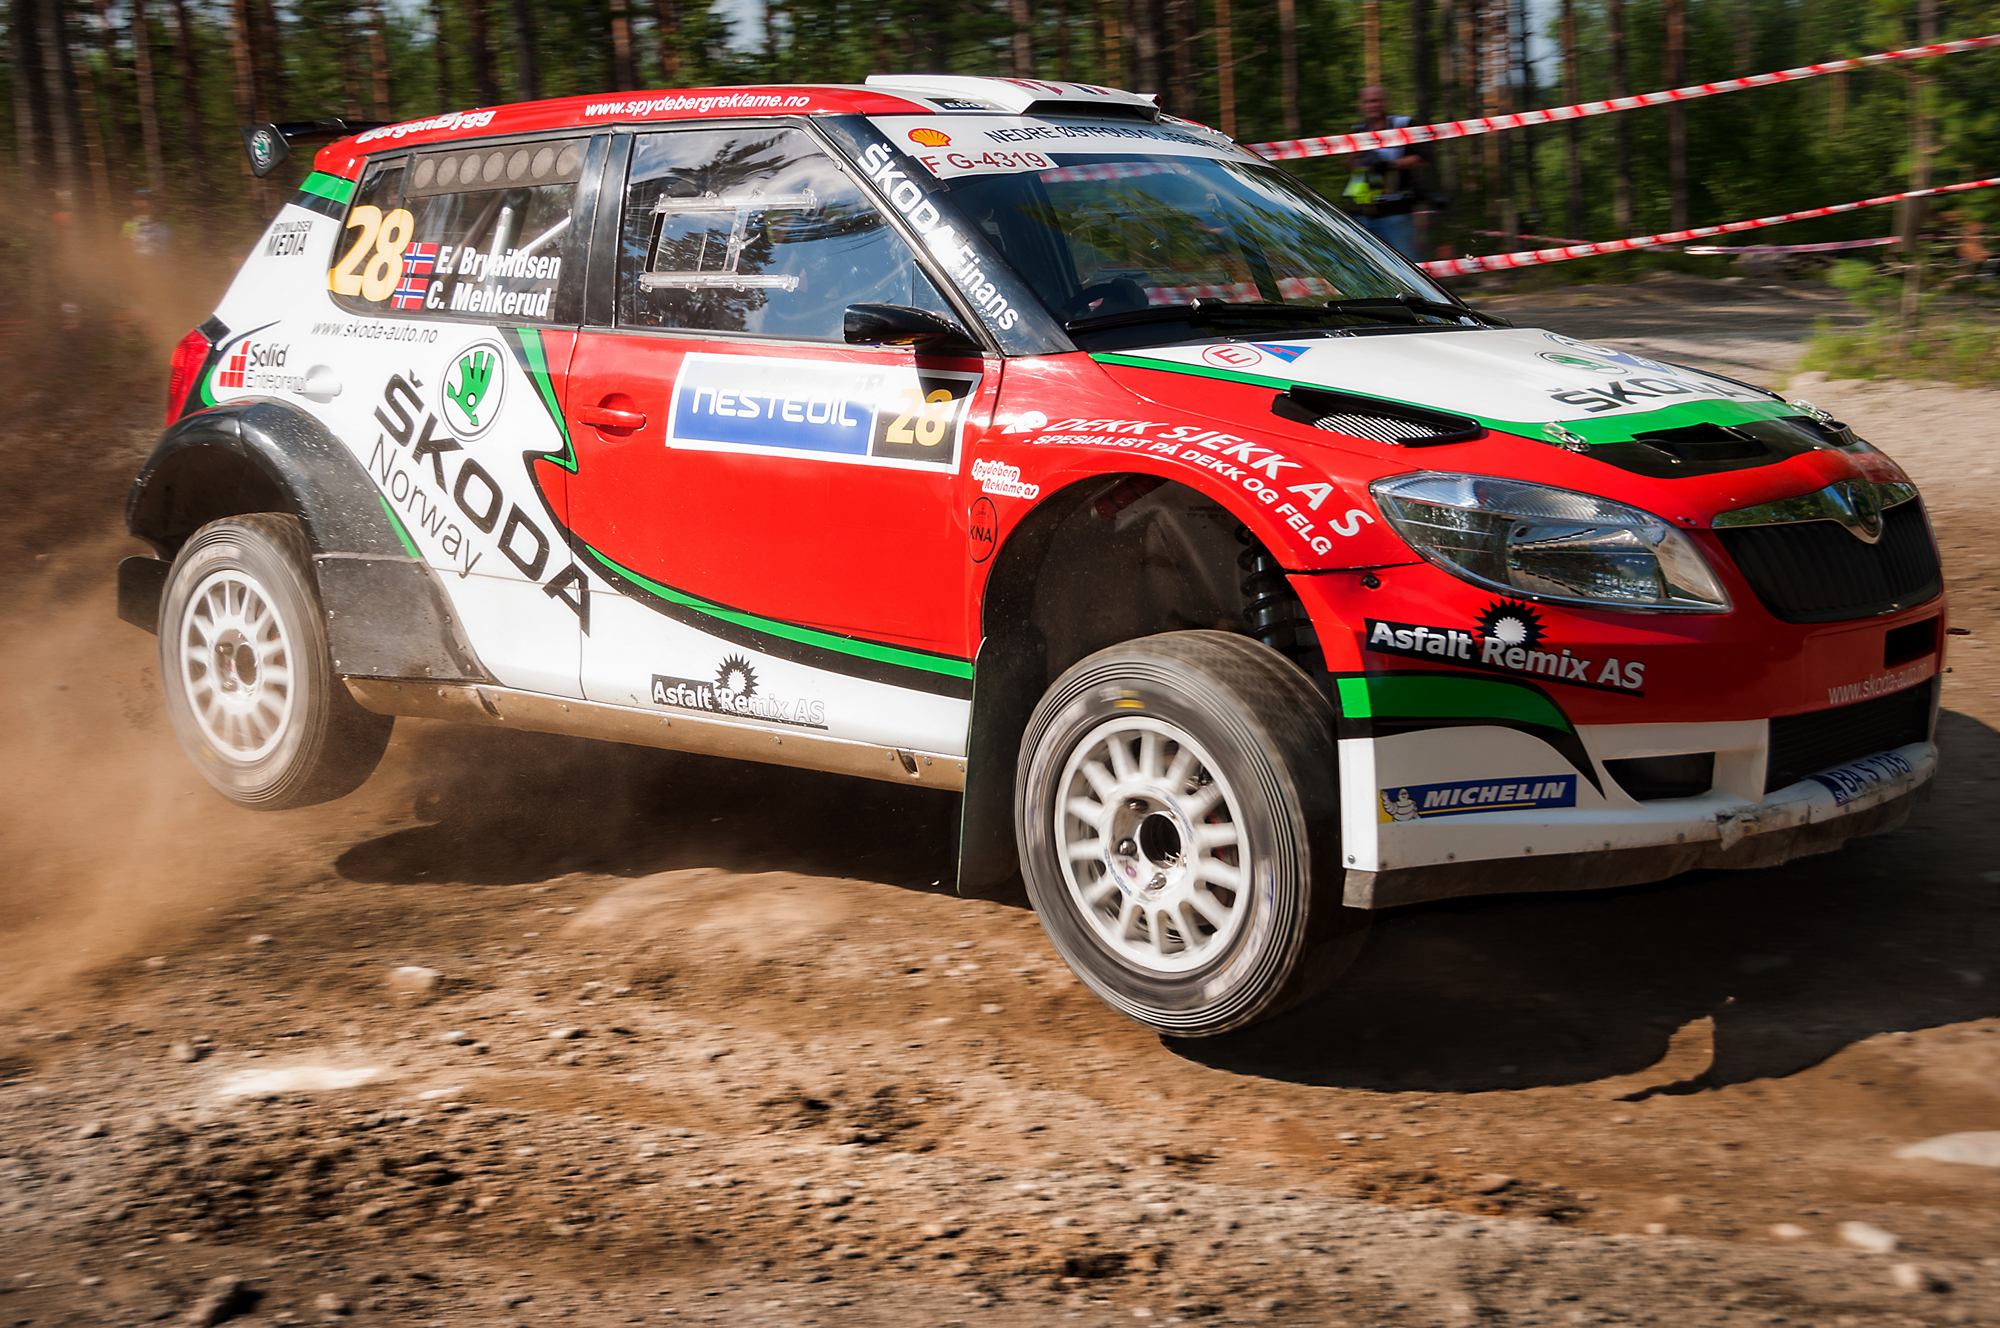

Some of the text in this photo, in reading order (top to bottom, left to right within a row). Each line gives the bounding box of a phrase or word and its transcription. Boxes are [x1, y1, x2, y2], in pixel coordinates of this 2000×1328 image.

[585, 94, 810, 117] www.spydebergreklame.no
[984, 126, 1060, 144] NEDRE
[919, 151, 1048, 174] F G-4319
[263, 232, 308, 257] MEDIA
[327, 205, 415, 303] 28
[435, 245, 454, 275] E.
[426, 280, 553, 317] C. Menkerud
[950, 244, 1019, 331] Finans
[311, 321, 439, 345] www.skoda-auto.no
[248, 344, 291, 368] Solid
[1211, 347, 1253, 365] E
[1546, 377, 1762, 413] ŠKODA
[885, 387, 954, 447] 28
[1042, 417, 1169, 435] DEKK
[1158, 425, 1303, 481] SJEKK
[973, 461, 1018, 482] Spydeberg
[984, 477, 1023, 495] Reklame
[368, 433, 483, 579] Norway
[373, 368, 591, 638] ŠKODA
[1032, 434, 1333, 556] SPESIALIST PÅ DEKK OG FELG
[969, 525, 993, 543] KNA
[1369, 621, 1646, 690] Asfalt Remix AS
[1827, 662, 1928, 705] www.skoda-auto.no
[653, 680, 825, 725] Asfalt Remix AS
[1423, 781, 1567, 809] MICHELIN
